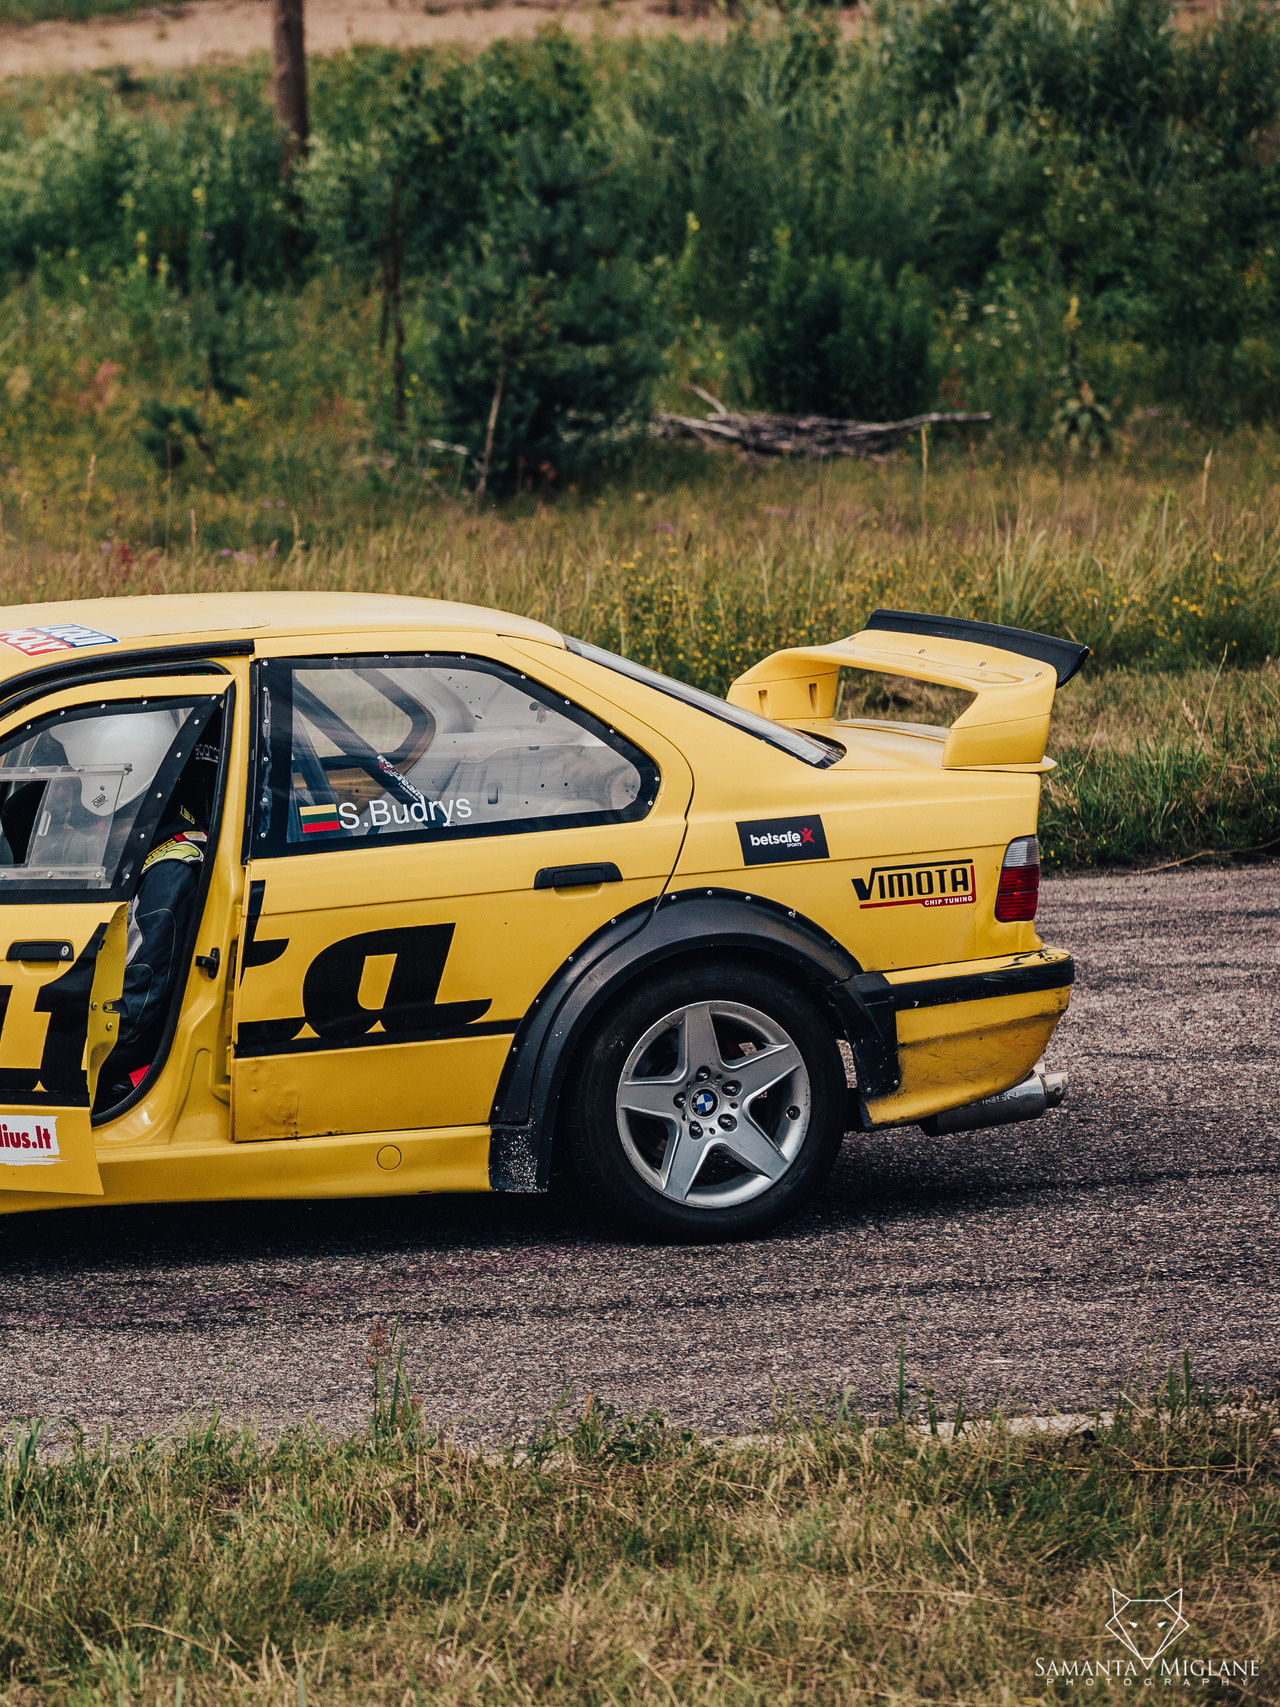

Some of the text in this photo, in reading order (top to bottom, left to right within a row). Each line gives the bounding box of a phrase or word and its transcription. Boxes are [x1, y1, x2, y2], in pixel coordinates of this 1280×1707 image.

[93, 794, 107, 807] OMP
[338, 796, 472, 830] S.Budrys
[750, 830, 801, 847] betsafe
[851, 859, 974, 901] VIMOTA
[924, 895, 973, 906] CHIP TUNING
